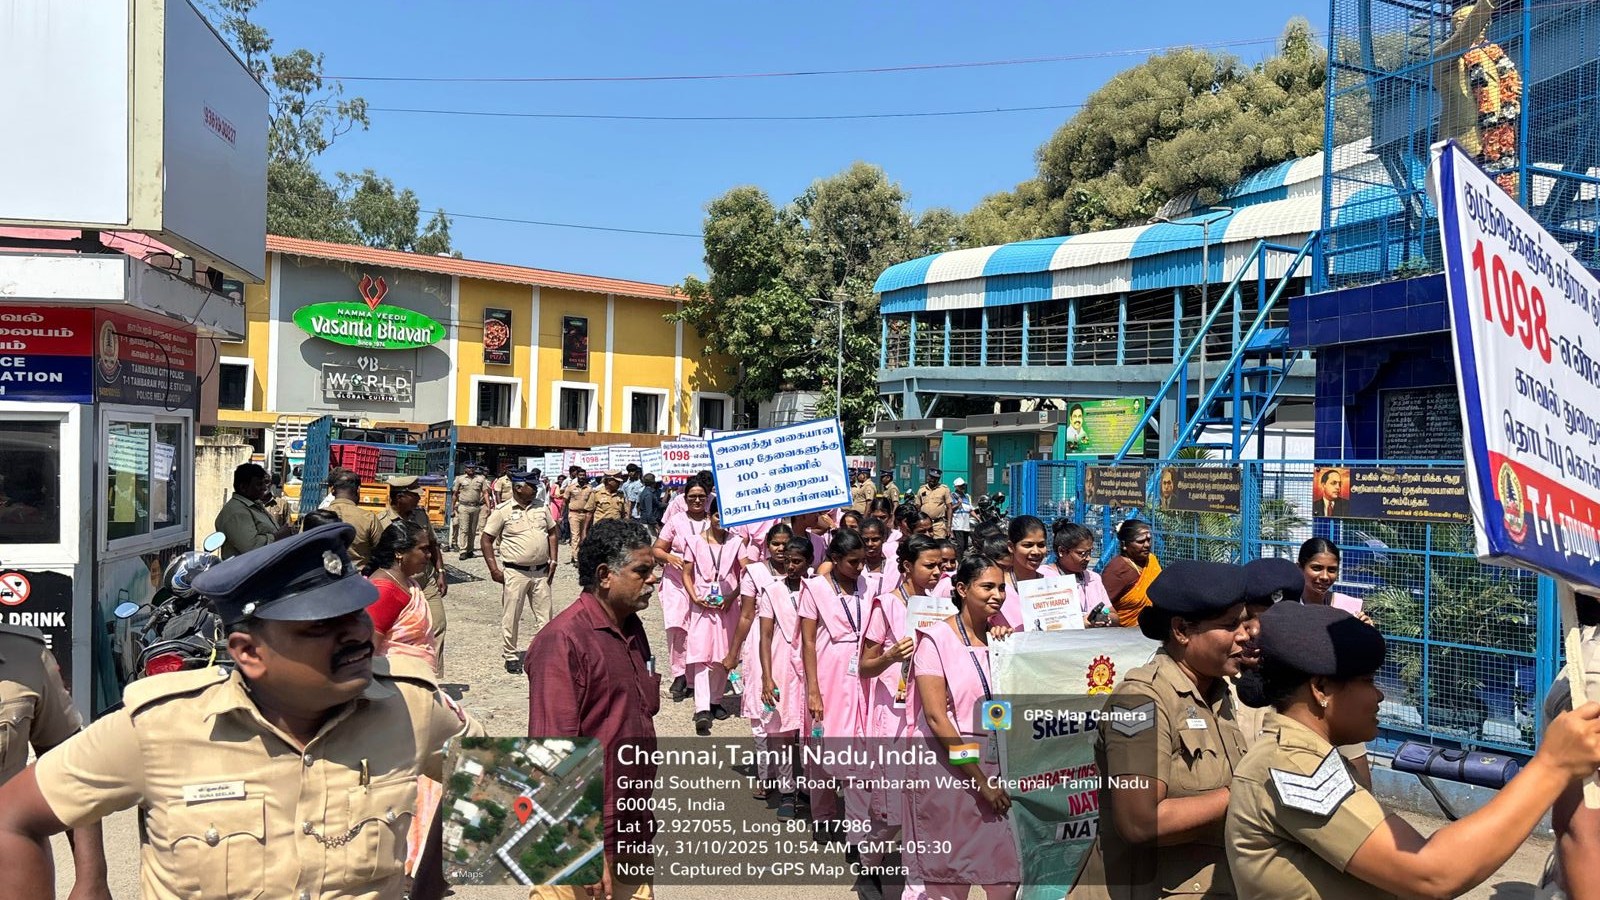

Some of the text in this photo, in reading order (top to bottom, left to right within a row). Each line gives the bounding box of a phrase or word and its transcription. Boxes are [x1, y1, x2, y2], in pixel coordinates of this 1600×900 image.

[1464, 181, 1555, 288] குழந்தைகளுக்கு
[337, 308, 407, 322] NAMMA VEEDU
[311, 316, 432, 344] Vasanta Bhavan
[131, 363, 158, 376] TAMBARAM
[169, 369, 185, 380] POLICE
[130, 376, 158, 389] TAMBARAM
[157, 380, 173, 390] POLIE
[173, 383, 192, 393] STATION
[136, 390, 153, 401] POLICE
[1514, 367, 1600, 446] காவல் துறை
[715, 426, 834, 456] அனைத்து வகையான
[1503, 408, 1565, 478] தொடர்பு
[1566, 445, 1600, 490] கொள்
[663, 450, 690, 461] 1098
[716, 440, 839, 471] உடனடி தேவைகளுக்கு
[671, 476, 682, 485] T-1
[737, 471, 759, 483] 100
[769, 458, 822, 477] எண்ணில்
[735, 474, 829, 498] காவல் துறையை
[724, 485, 845, 516] தொடர்பு கொள்ளவும்.
[1526, 484, 1560, 553] T-1
[1032, 598, 1070, 610] UNITY MARCH
[9, 612, 66, 627] DRINK
[1033, 712, 1079, 740] SREE
[1077, 763, 1098, 779] INS
[1068, 790, 1099, 816] NAT
